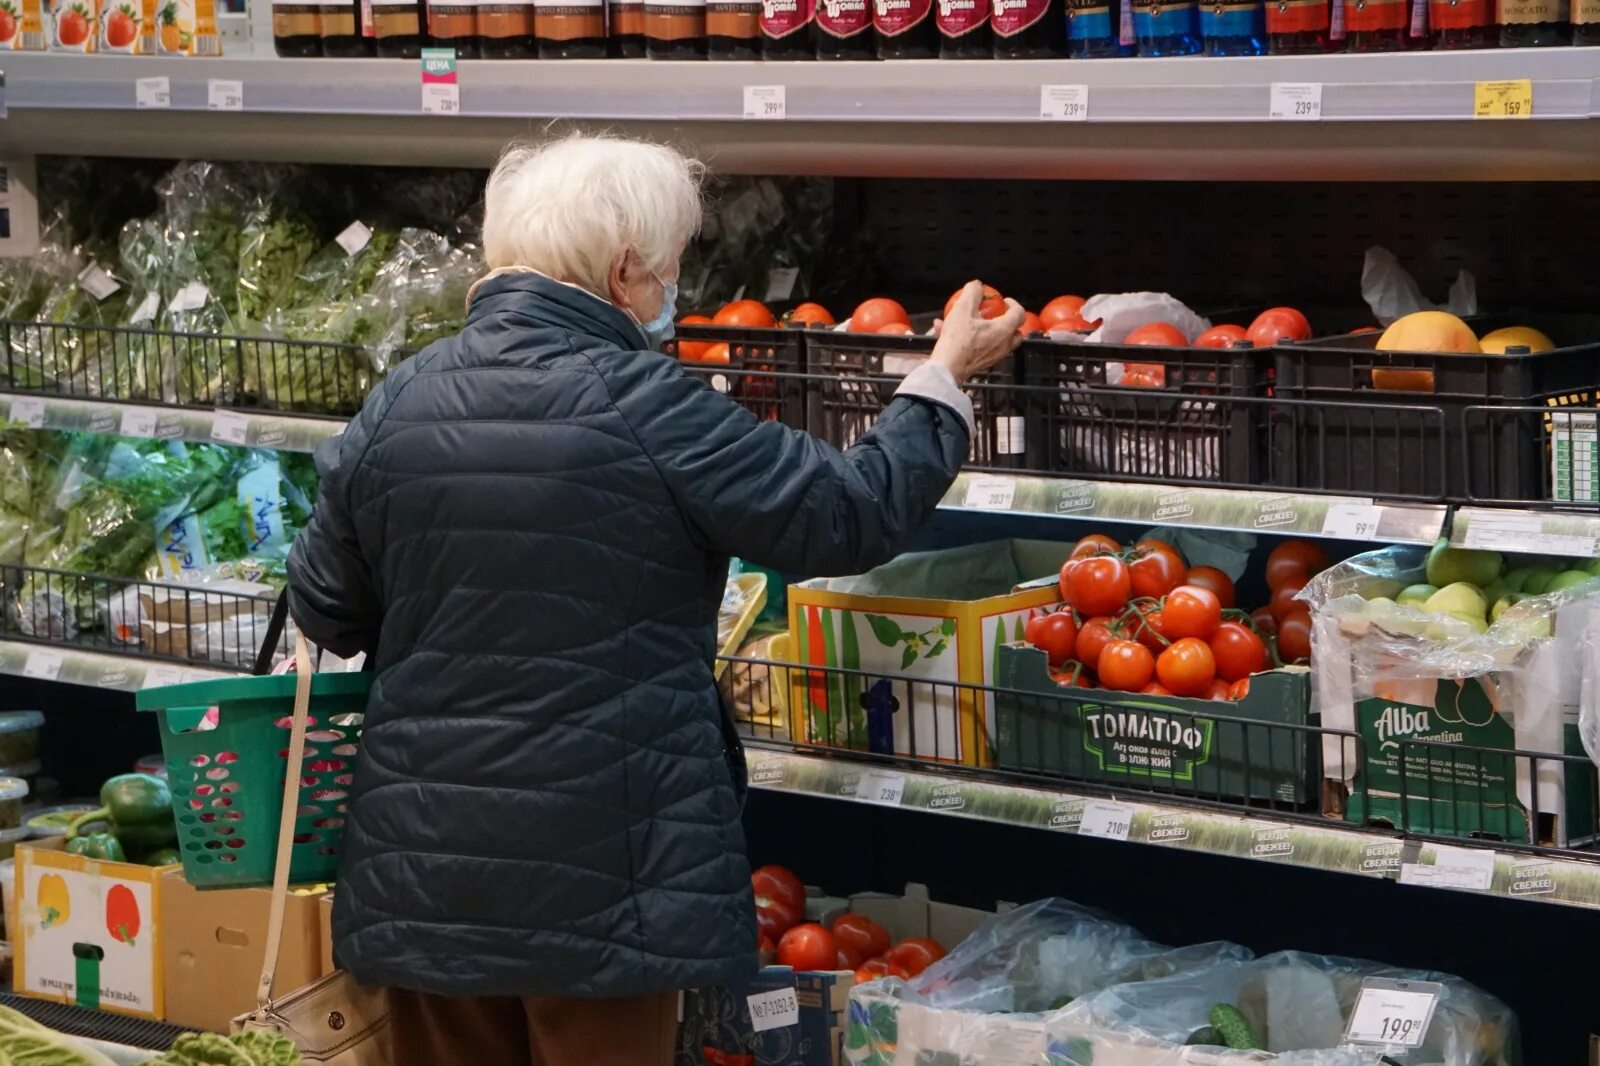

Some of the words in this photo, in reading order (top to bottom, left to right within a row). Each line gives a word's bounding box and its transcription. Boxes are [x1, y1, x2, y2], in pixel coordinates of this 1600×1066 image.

[1504, 6, 1548, 15] MOSCATO
[426, 60, 450, 71] ЦЕНА
[1355, 523, 1367, 535] 99
[1374, 707, 1430, 741] Alba
[1152, 828, 1186, 839] СВЕЖЕЕ!
[1255, 841, 1291, 853] СВЕЖЕЕ!
[1513, 879, 1552, 891] СВЕЖЕЕ!
[1381, 1017, 1412, 1041] 199
